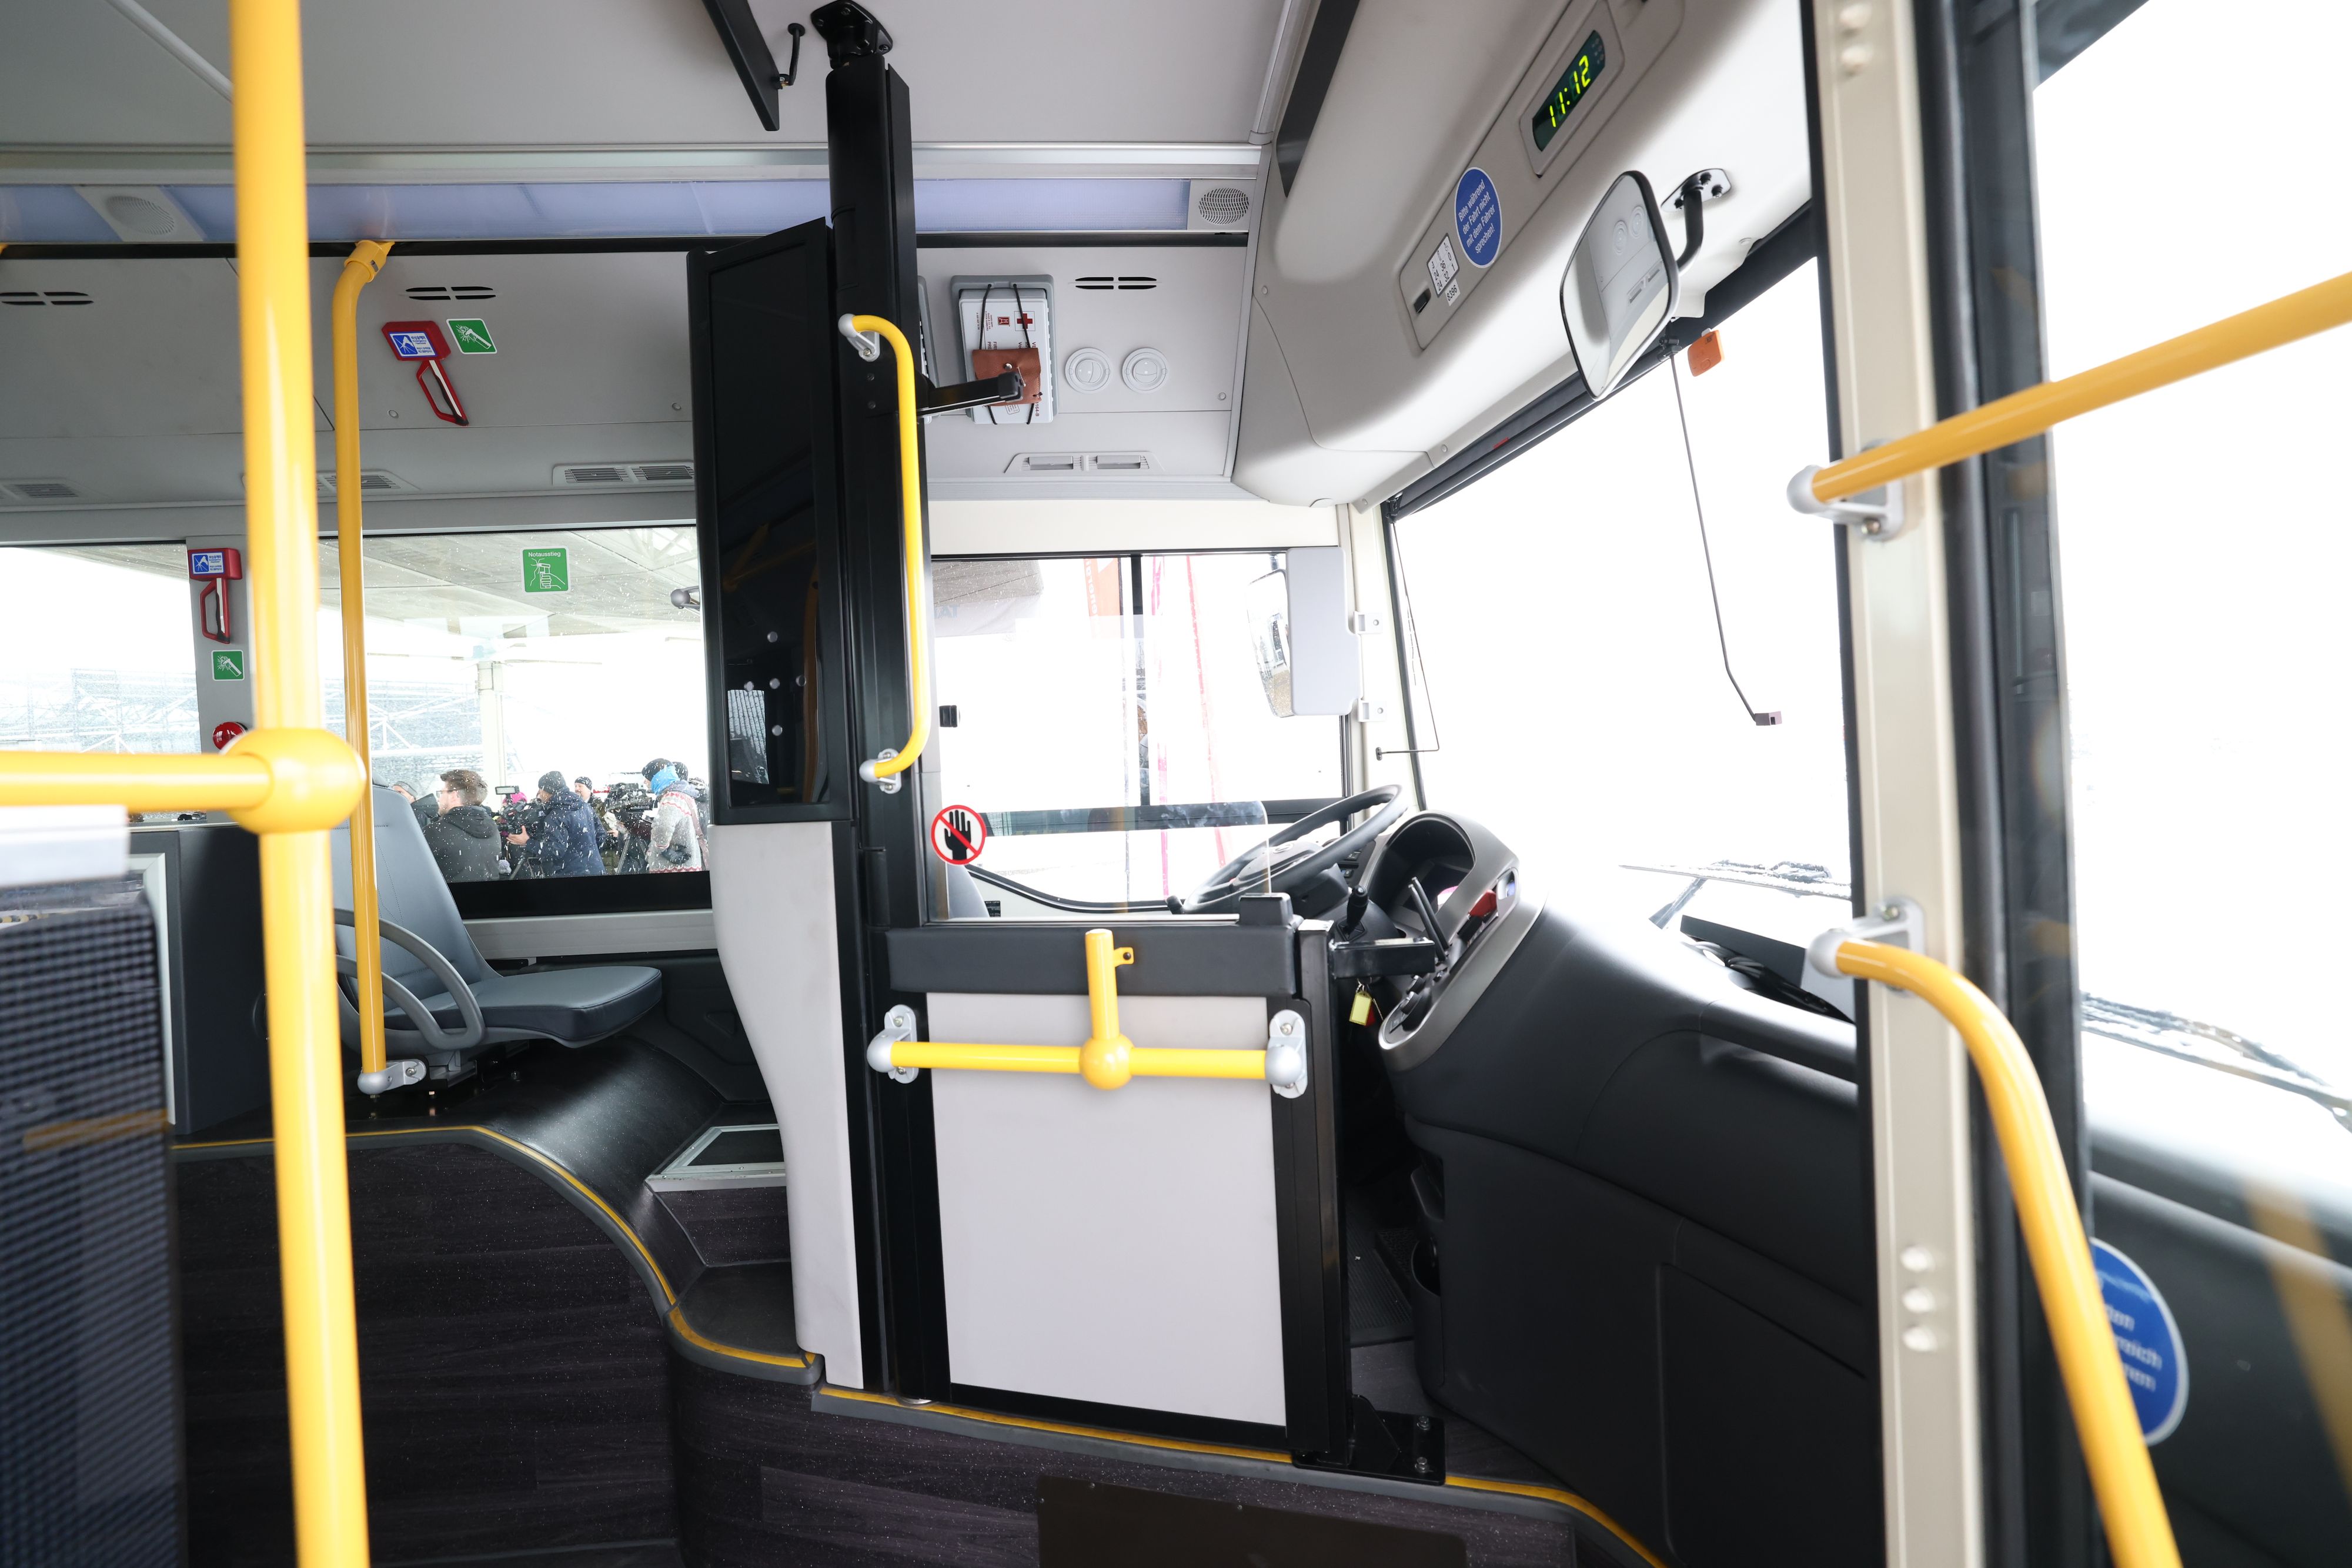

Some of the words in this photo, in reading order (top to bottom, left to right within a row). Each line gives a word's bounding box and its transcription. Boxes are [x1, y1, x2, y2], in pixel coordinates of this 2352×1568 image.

[1549, 55, 1591, 128] 11:12
[1458, 206, 1469, 222] Bitte
[1468, 179, 1485, 209] während
[1468, 206, 1481, 226] Fahrt
[1479, 191, 1491, 211] nicht
[1466, 234, 1474, 248] mit
[1473, 223, 1483, 239] dem
[1481, 205, 1495, 227] Fahrer
[1475, 223, 1495, 253] sprechen!
[1434, 269, 1439, 280] 24
[1440, 260, 1446, 272] 36
[1448, 252, 1452, 261] 0
[1437, 280, 1443, 291] 24
[1444, 271, 1449, 282] 32
[1446, 285, 1458, 301] 8396
